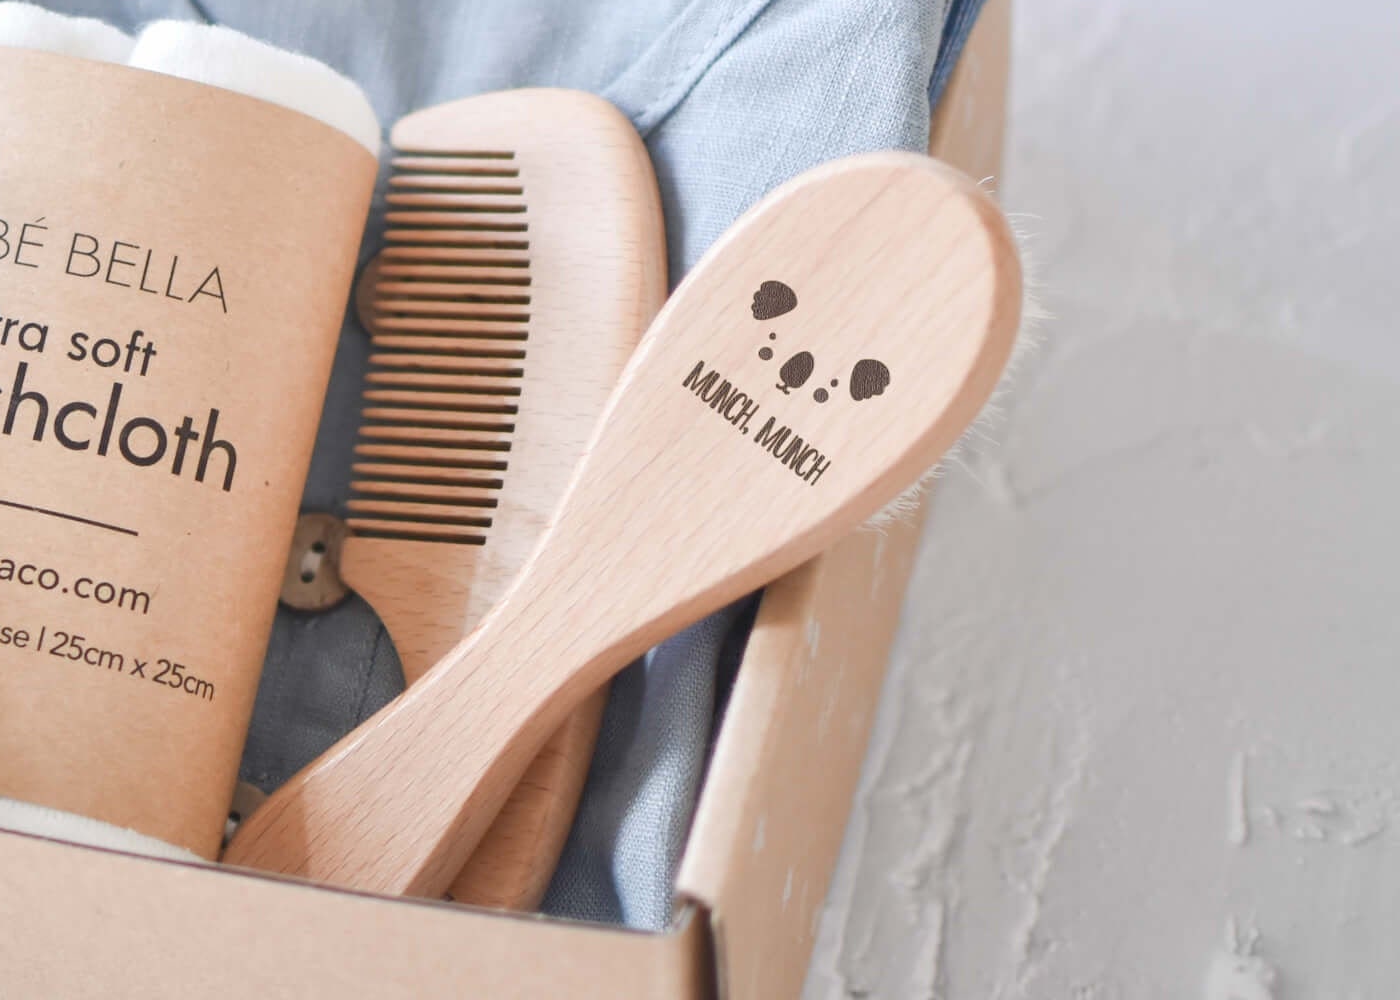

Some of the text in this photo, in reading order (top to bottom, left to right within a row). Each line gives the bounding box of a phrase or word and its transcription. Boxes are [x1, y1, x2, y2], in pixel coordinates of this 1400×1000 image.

[65, 232, 228, 314] BELLA
[67, 330, 158, 377] soft
[682, 360, 832, 486] MUNCH, MUNCH
[49, 631, 125, 672] 25cm
[130, 658, 148, 678] x
[152, 658, 216, 701] 25cm
